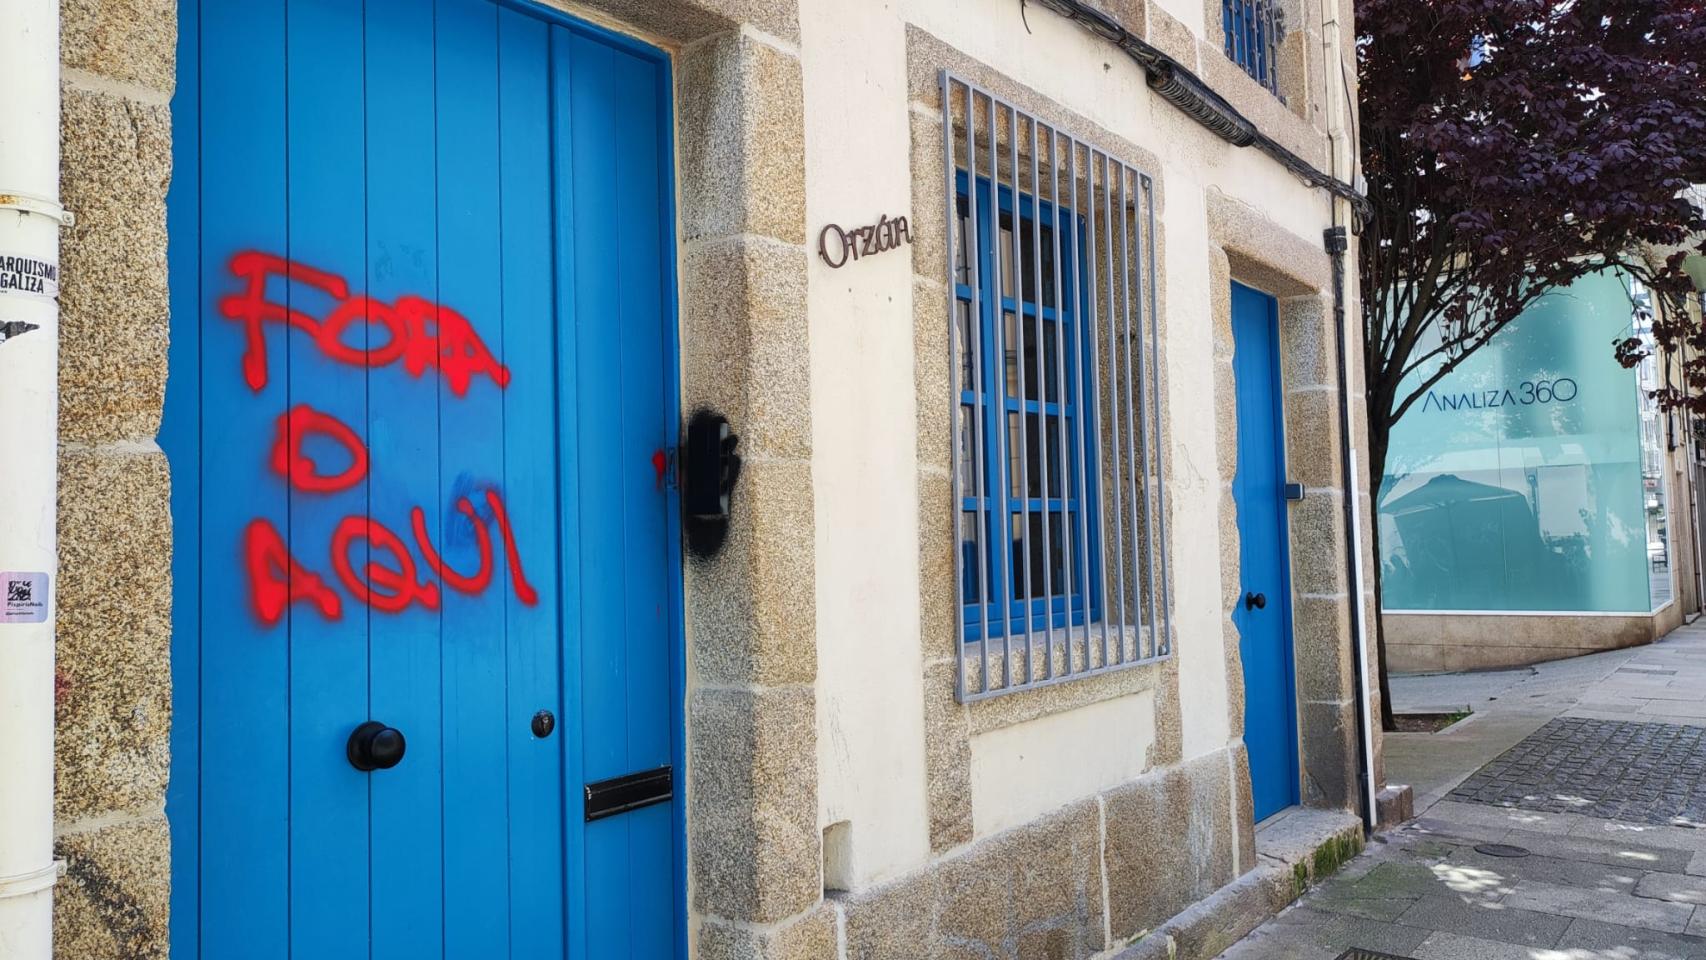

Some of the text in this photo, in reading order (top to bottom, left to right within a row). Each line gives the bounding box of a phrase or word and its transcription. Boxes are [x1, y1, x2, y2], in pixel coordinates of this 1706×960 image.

[819, 213, 913, 269] Orzán
[1422, 378, 1578, 413] ANALIZA 360
